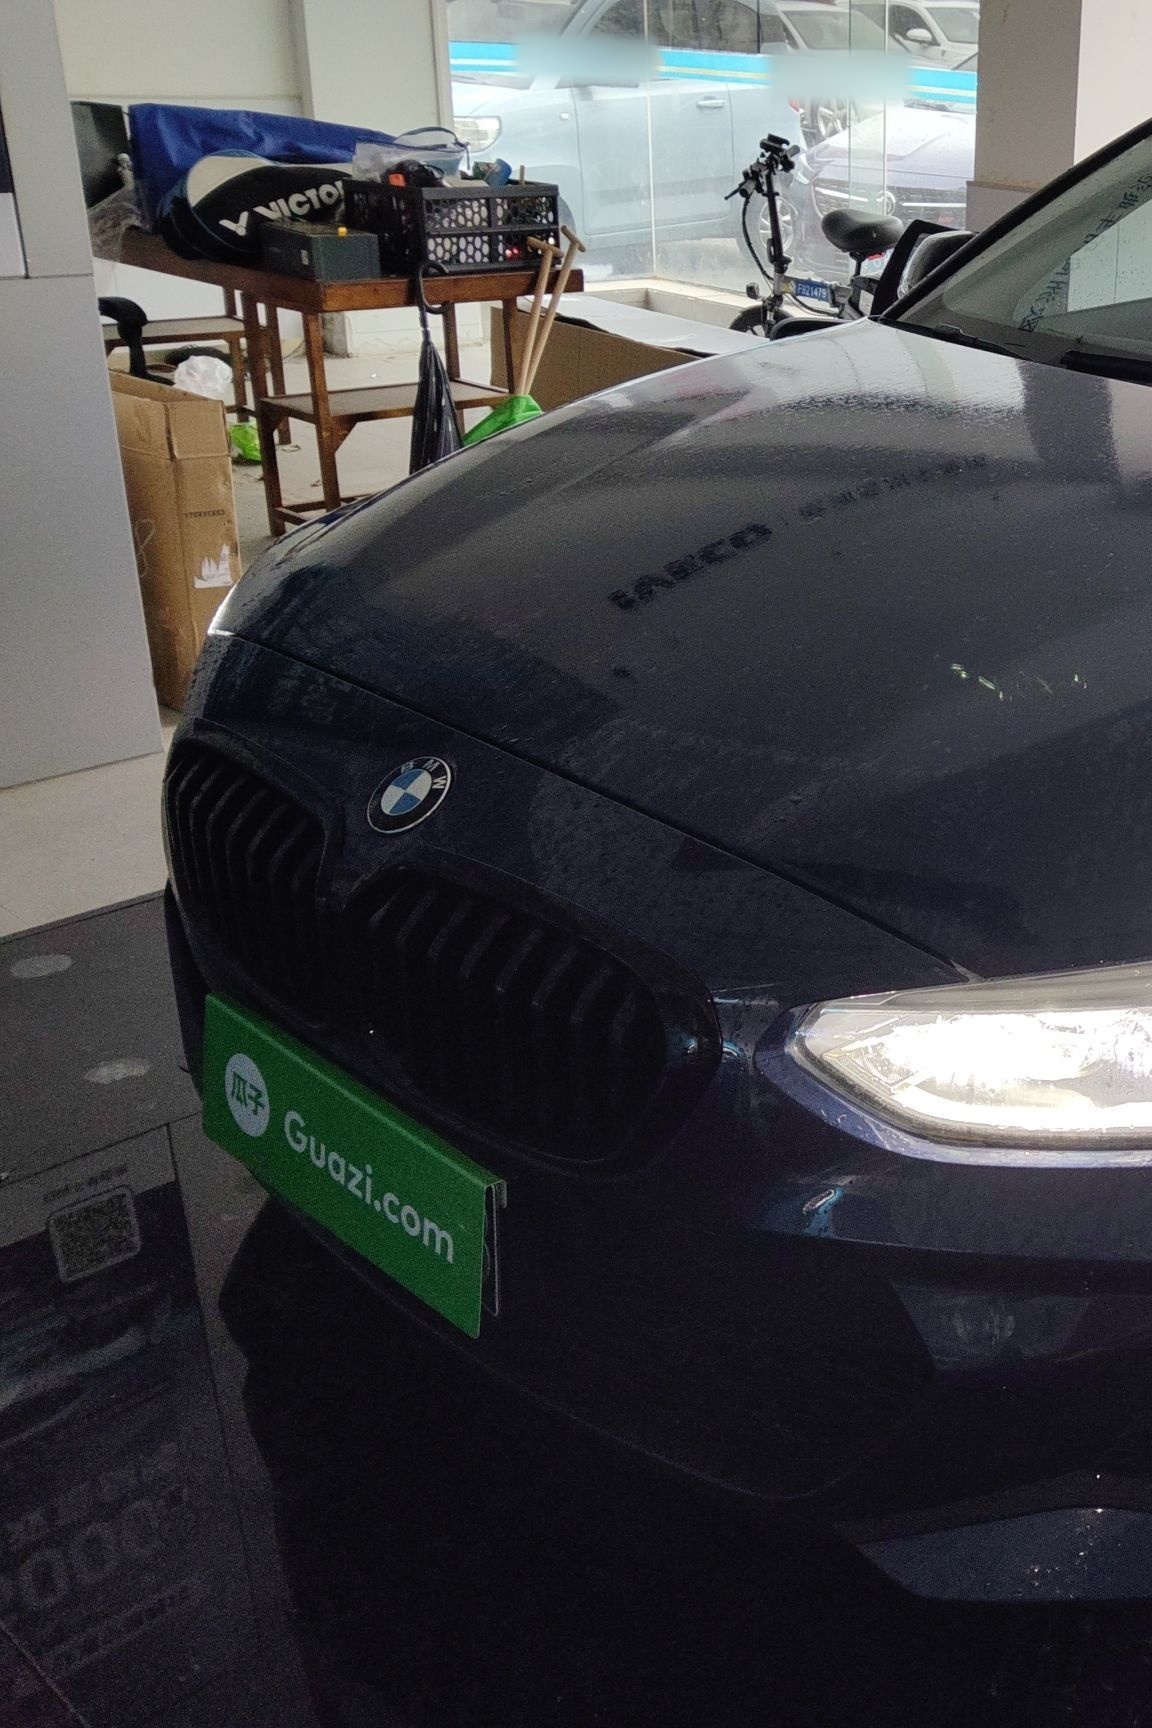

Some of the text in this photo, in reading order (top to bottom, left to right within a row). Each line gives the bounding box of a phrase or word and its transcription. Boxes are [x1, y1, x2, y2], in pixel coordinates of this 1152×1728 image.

[797, 283, 827, 298] F921479
[401, 759, 447, 790] BMW
[231, 1070, 266, 1116] 瓜子
[284, 1110, 454, 1265] Guazi.com
